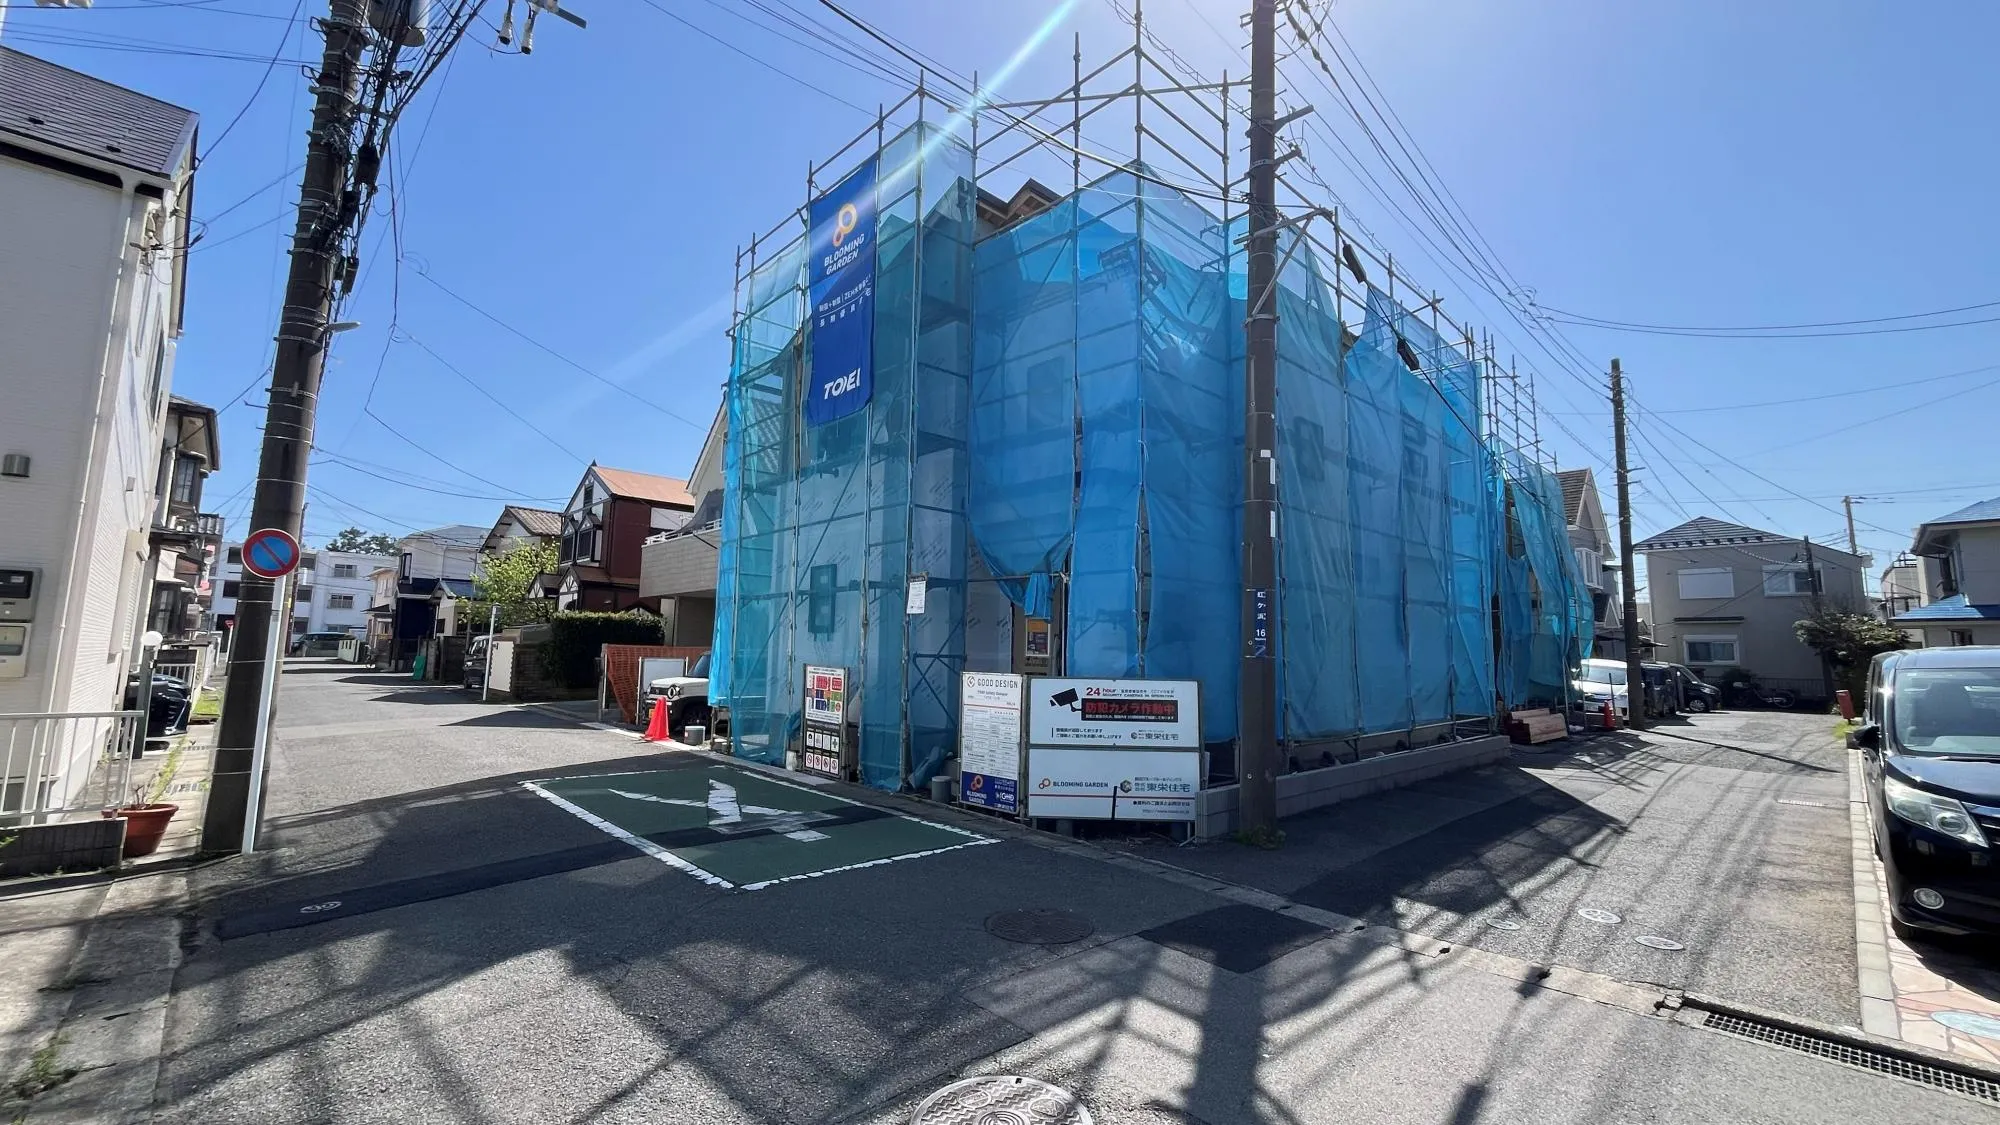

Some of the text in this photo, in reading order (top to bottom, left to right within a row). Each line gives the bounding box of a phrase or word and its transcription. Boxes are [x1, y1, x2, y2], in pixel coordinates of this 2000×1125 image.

[824, 233, 865, 267] BLOOMING
[826, 248, 859, 276] GARDEN
[824, 367, 861, 400] TOEI
[1256, 628, 1266, 637] 16
[977, 678, 1018, 689] GOOD DESIGN
[1086, 686, 1101, 696] 24
[1085, 702, 1176, 715] 防犯カメラ作動中
[1147, 782, 1191, 793] 東栄住宅
